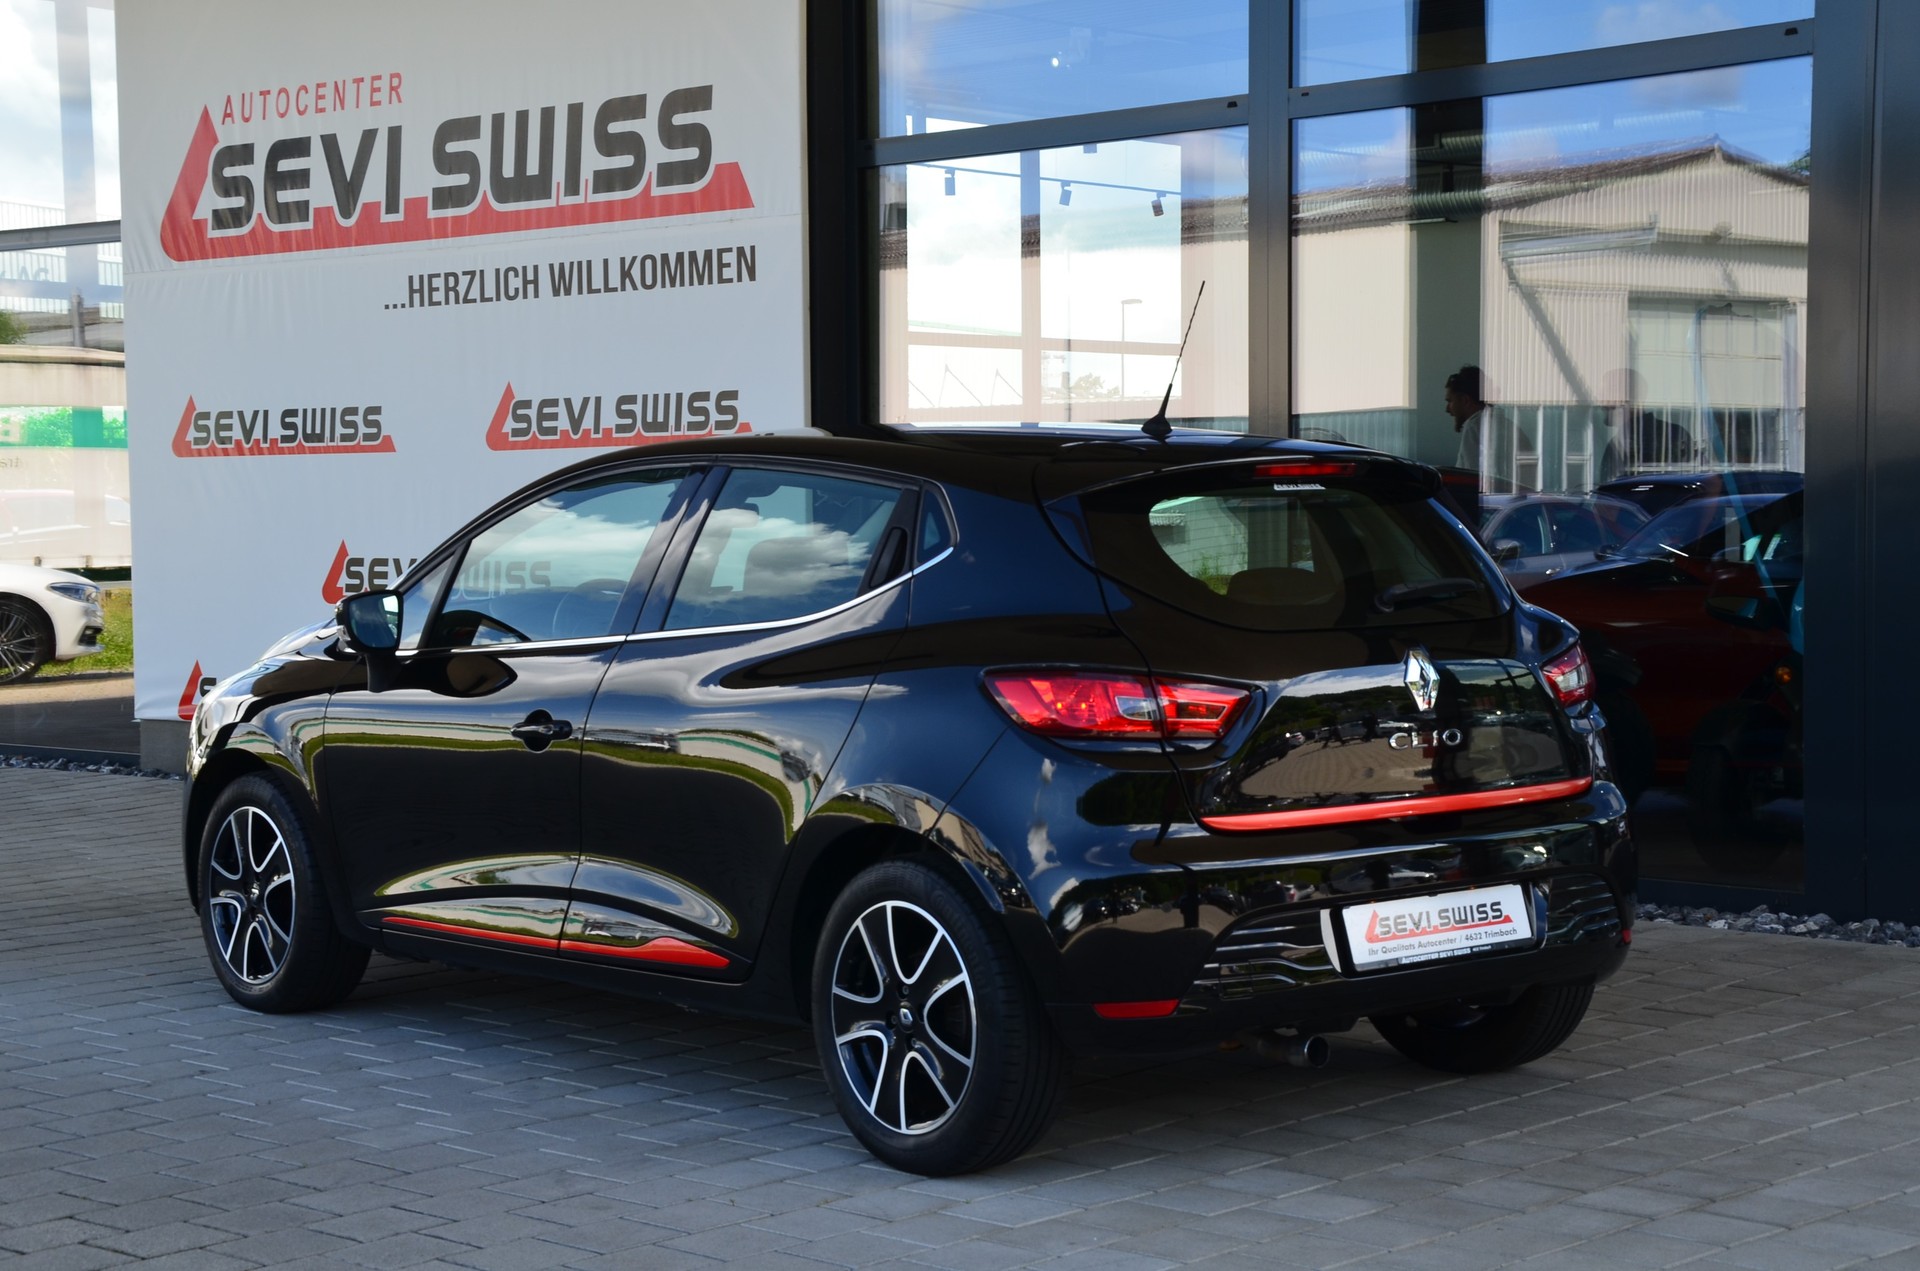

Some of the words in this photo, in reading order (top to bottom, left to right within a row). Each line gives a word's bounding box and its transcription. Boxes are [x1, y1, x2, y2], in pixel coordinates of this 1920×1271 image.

[222, 72, 402, 125] AUTOCENTER
[211, 125, 402, 231] SEVI
[432, 84, 713, 211] SWISS
[548, 244, 757, 298] WILLKOMMEN
[193, 409, 269, 446] SEVI
[279, 405, 382, 444] SWISS
[510, 396, 602, 438] SEVI
[614, 389, 739, 434] SWISS
[344, 557, 418, 592] SEV
[453, 560, 552, 598] WISS
[1389, 729, 1463, 750] CLIO
[1378, 910, 1432, 936] SEVI
[1438, 901, 1503, 928] SWISS
[1417, 937, 1457, 949] Autocenter
[1464, 932, 1483, 941] 4632
[1484, 927, 1517, 939] Trimbach
